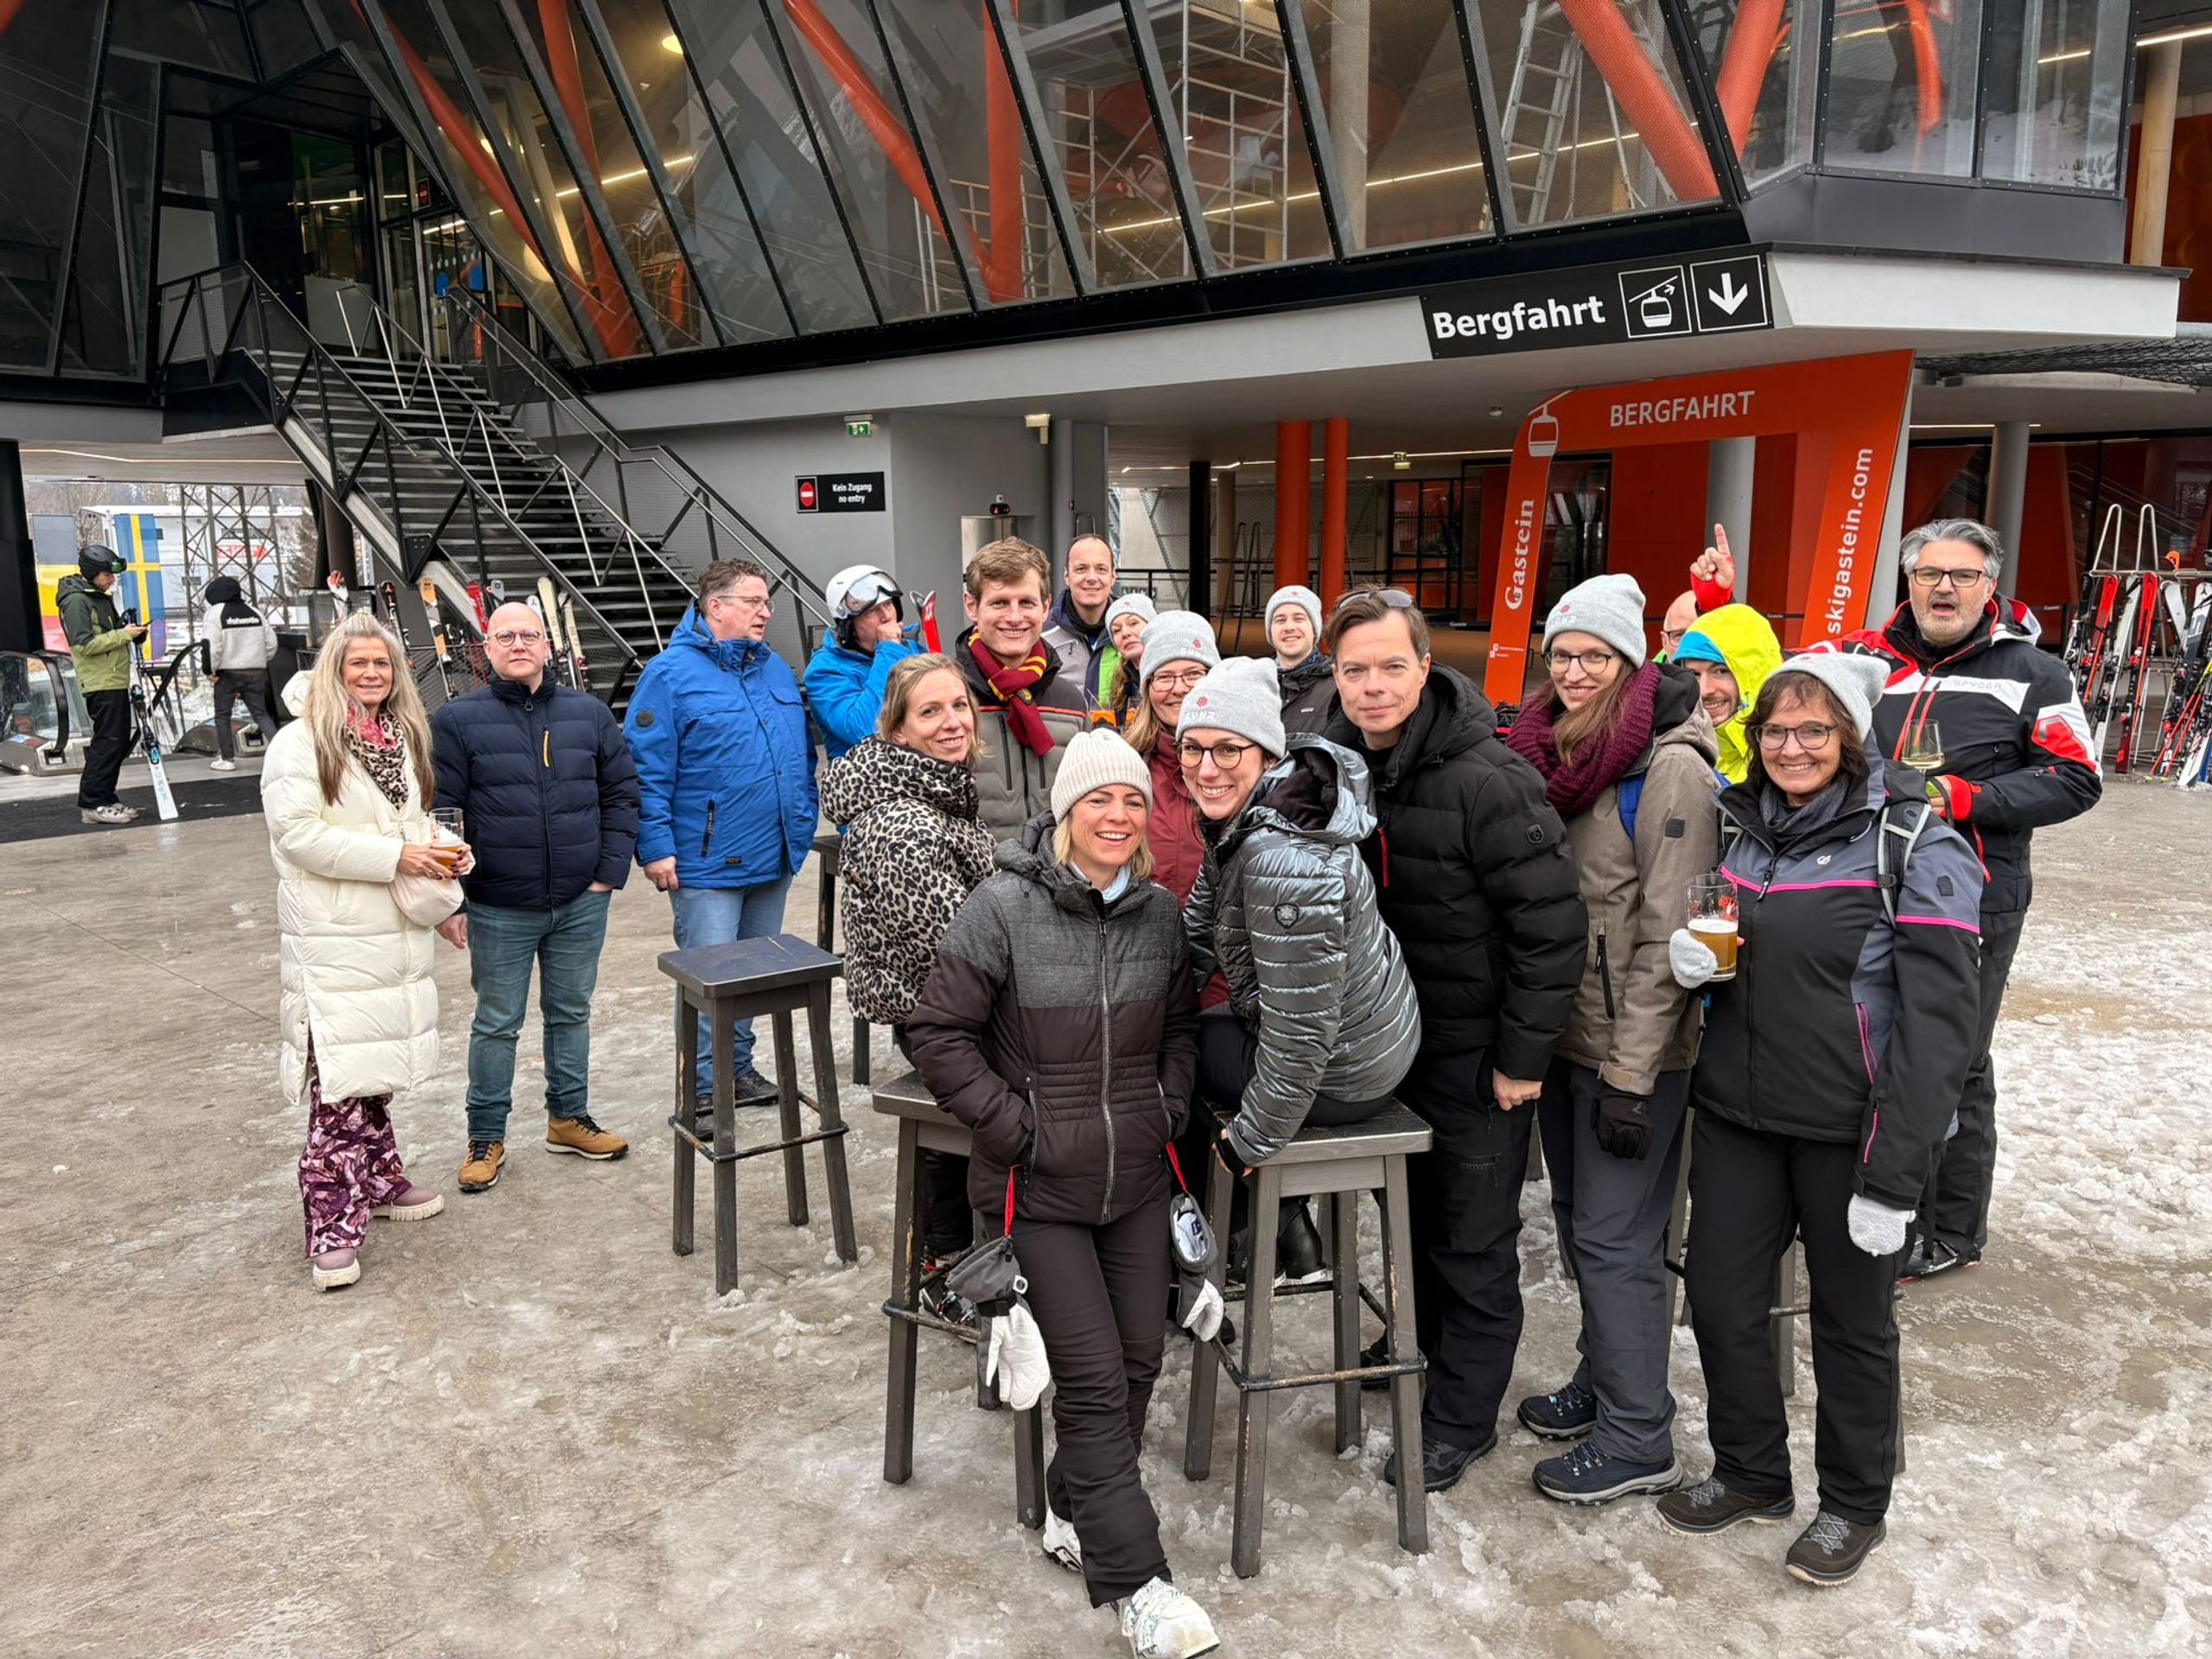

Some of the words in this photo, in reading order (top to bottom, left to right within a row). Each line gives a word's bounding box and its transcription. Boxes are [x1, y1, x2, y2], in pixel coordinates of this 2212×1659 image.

[1433, 295, 1606, 340] Bergfahrt
[1610, 390, 1755, 428] BERGFAHRT
[832, 483, 847, 493] Kein
[848, 483, 873, 493] Zugang
[848, 494, 866, 504] entry
[1504, 499, 1535, 610] Gastein
[1825, 448, 1873, 634] skigastein.com
